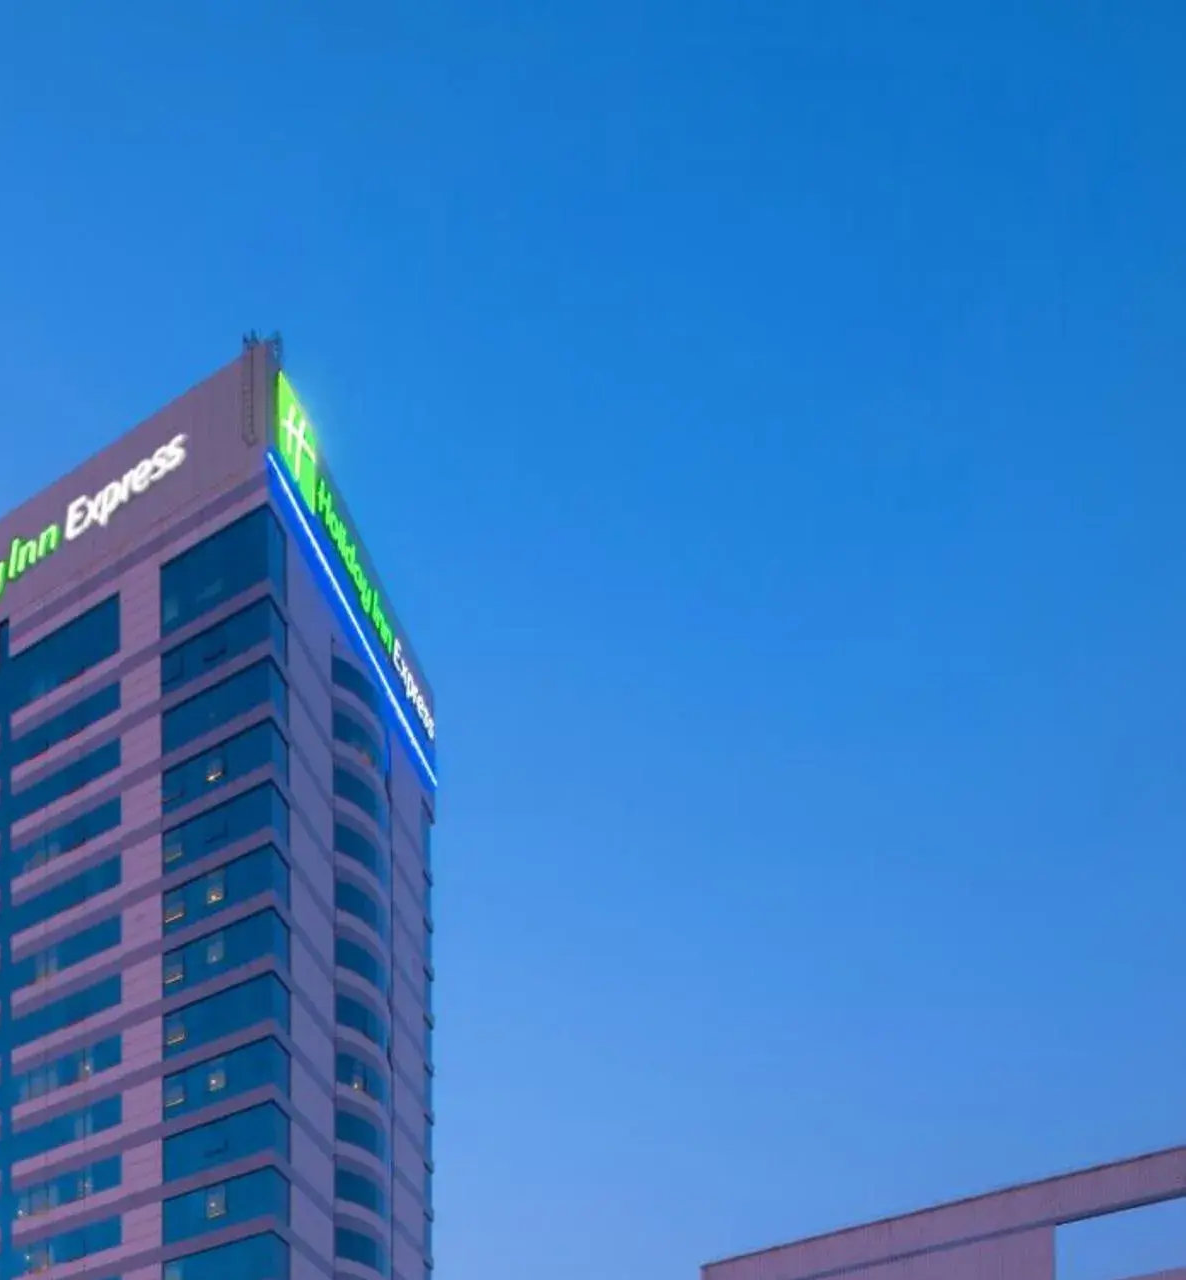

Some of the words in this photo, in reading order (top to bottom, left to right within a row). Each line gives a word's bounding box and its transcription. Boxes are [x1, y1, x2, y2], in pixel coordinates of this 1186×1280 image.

[8, 523, 61, 580] Inn
[65, 433, 189, 541] Express
[317, 481, 372, 613] Holiday
[370, 591, 393, 655] Inn
[391, 639, 436, 741] Express
